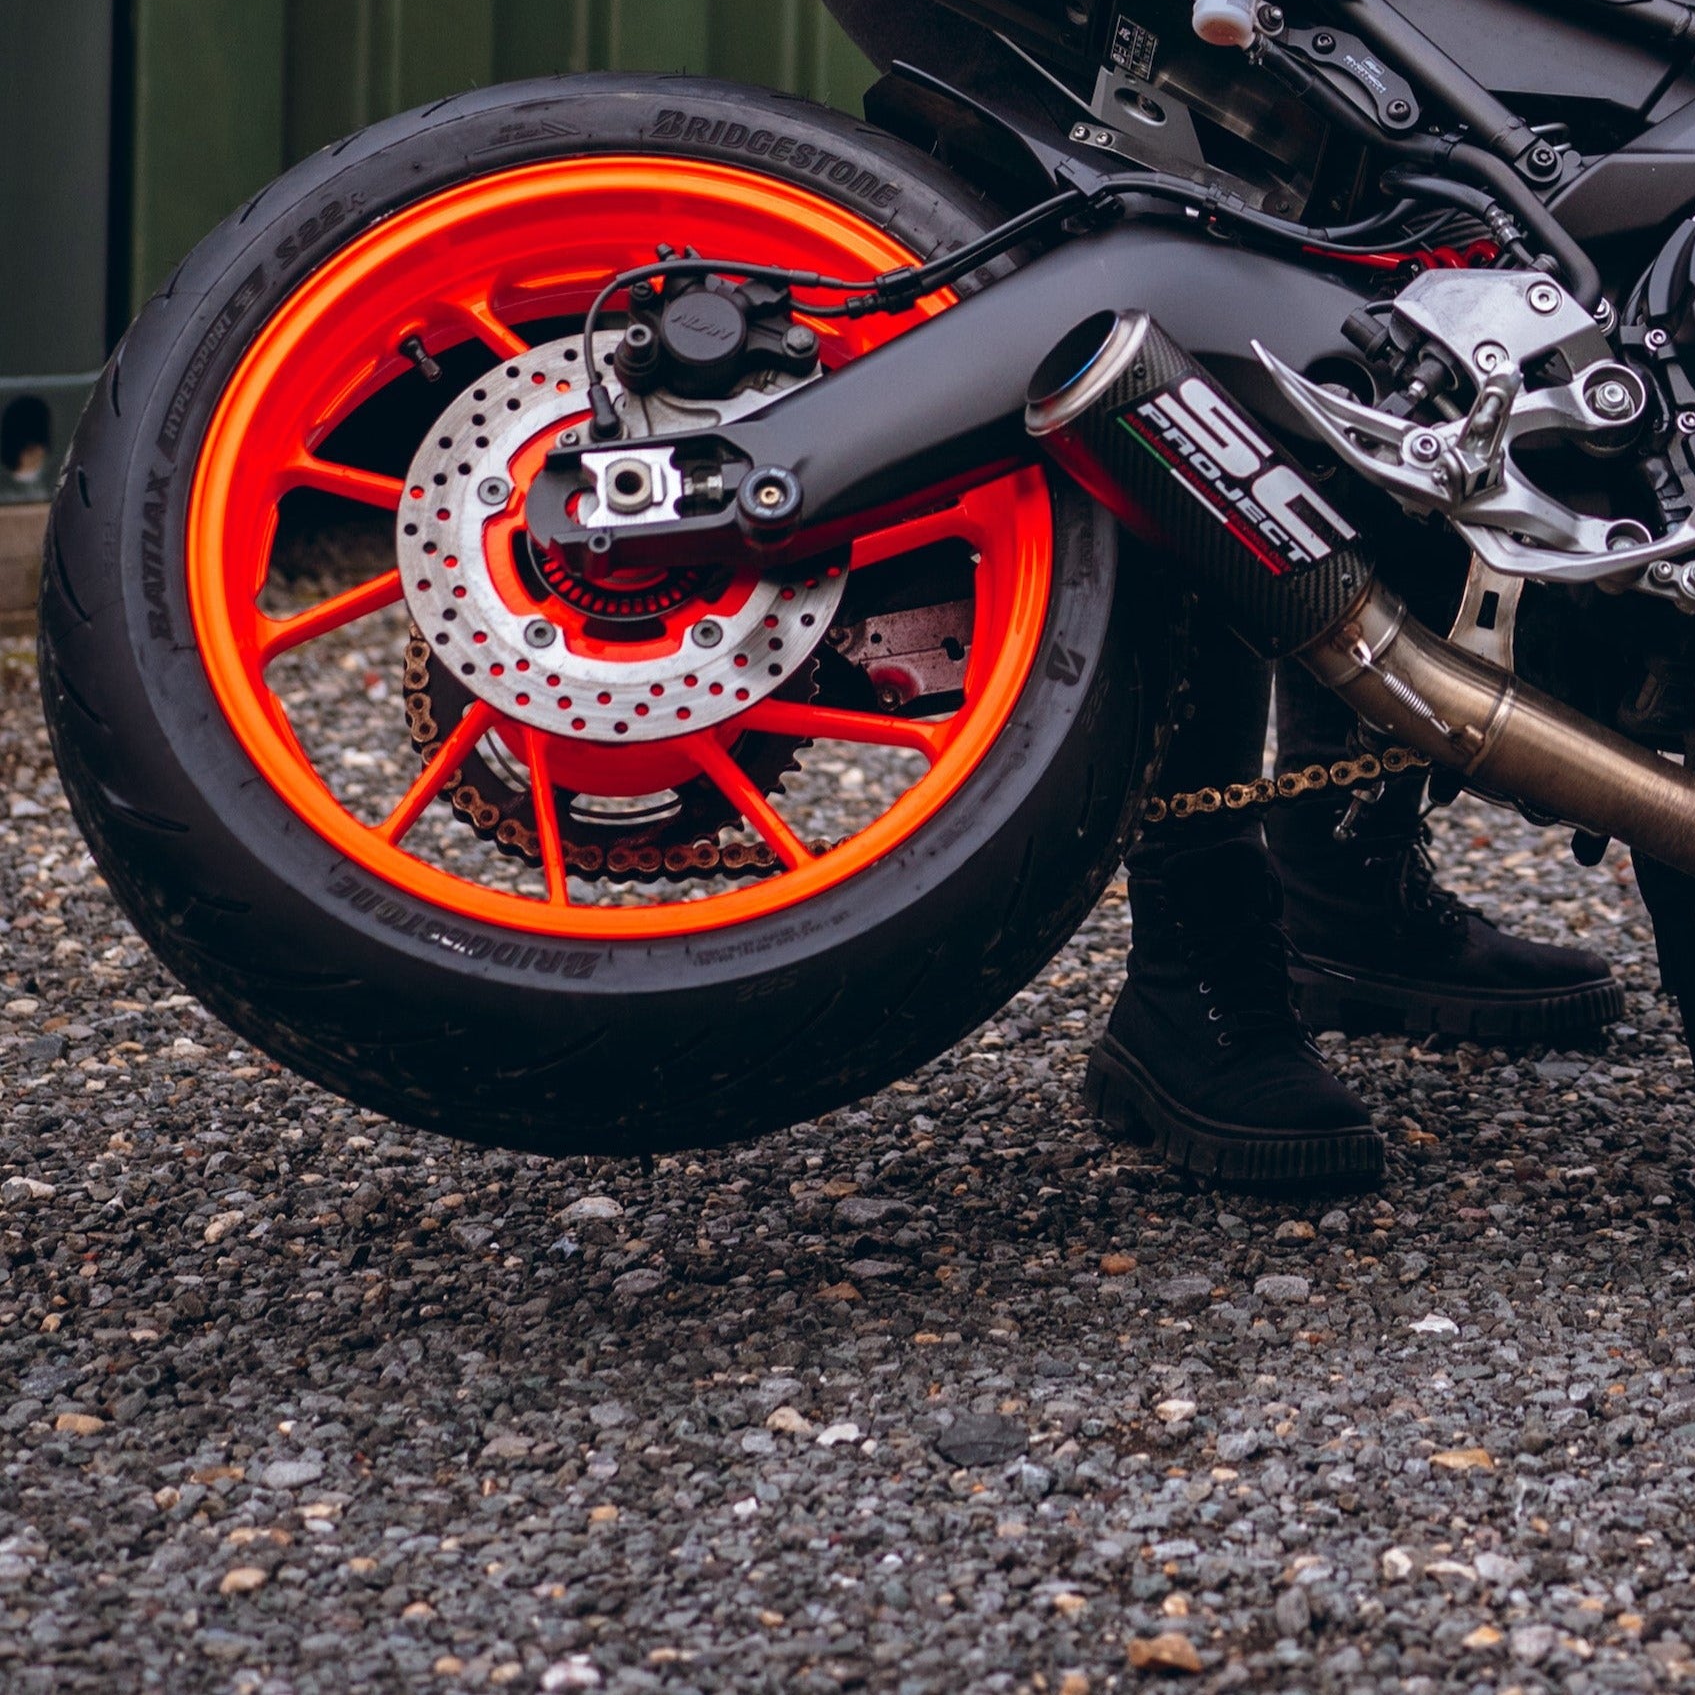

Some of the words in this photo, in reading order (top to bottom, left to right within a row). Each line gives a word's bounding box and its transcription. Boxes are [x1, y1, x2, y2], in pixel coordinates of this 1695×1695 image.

[650, 109, 902, 208] BRIDGESTONE
[1136, 402, 1313, 563] PROJECT
[1153, 376, 1358, 561] SC
